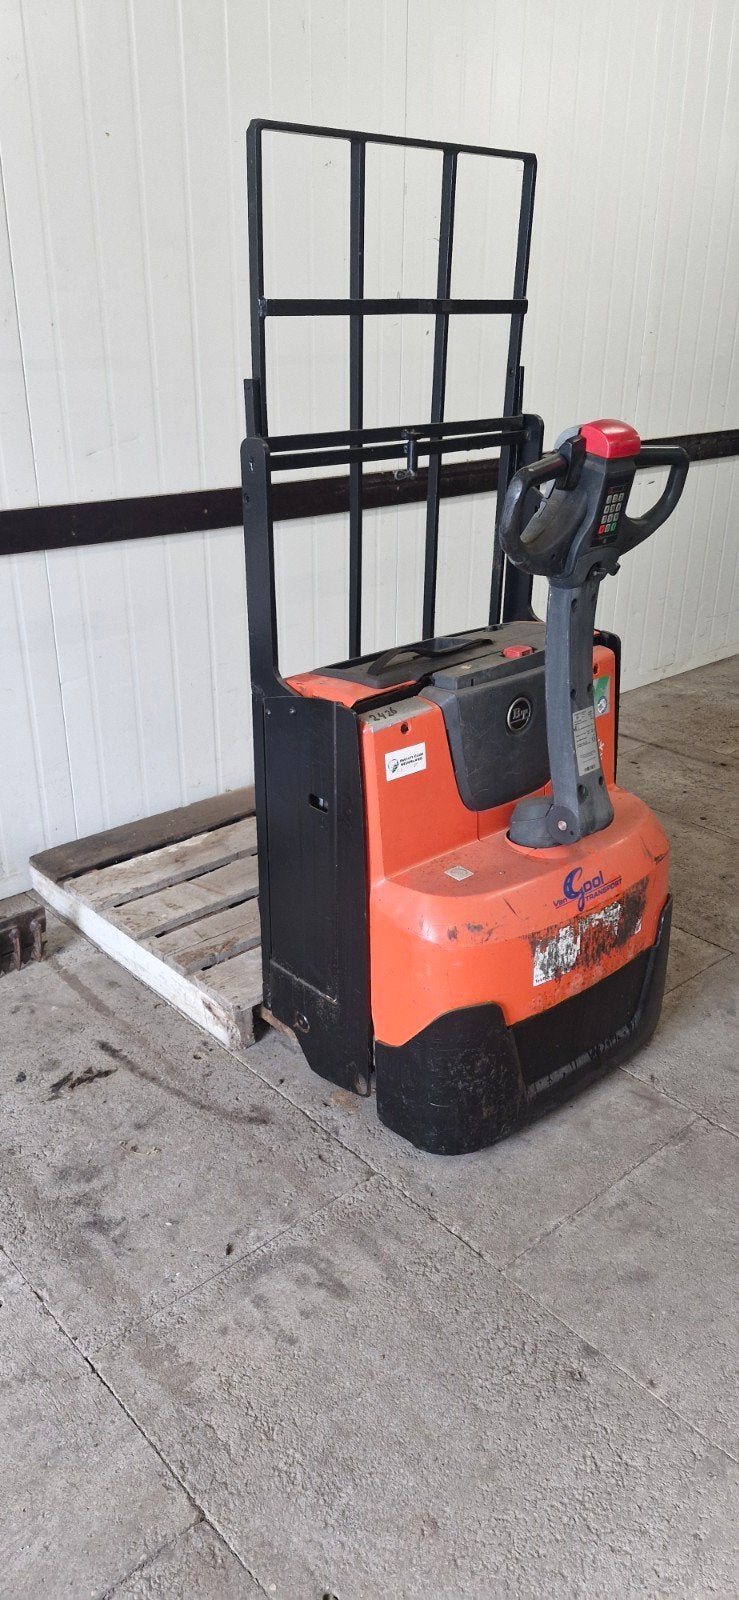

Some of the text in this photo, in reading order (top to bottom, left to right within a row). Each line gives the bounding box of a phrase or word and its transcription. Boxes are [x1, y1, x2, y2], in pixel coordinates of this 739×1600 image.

[369, 707, 397, 721] 2426
[512, 708, 529, 720] BT
[553, 867, 604, 912] Van Gool
[585, 878, 622, 901] TRANSPORT
